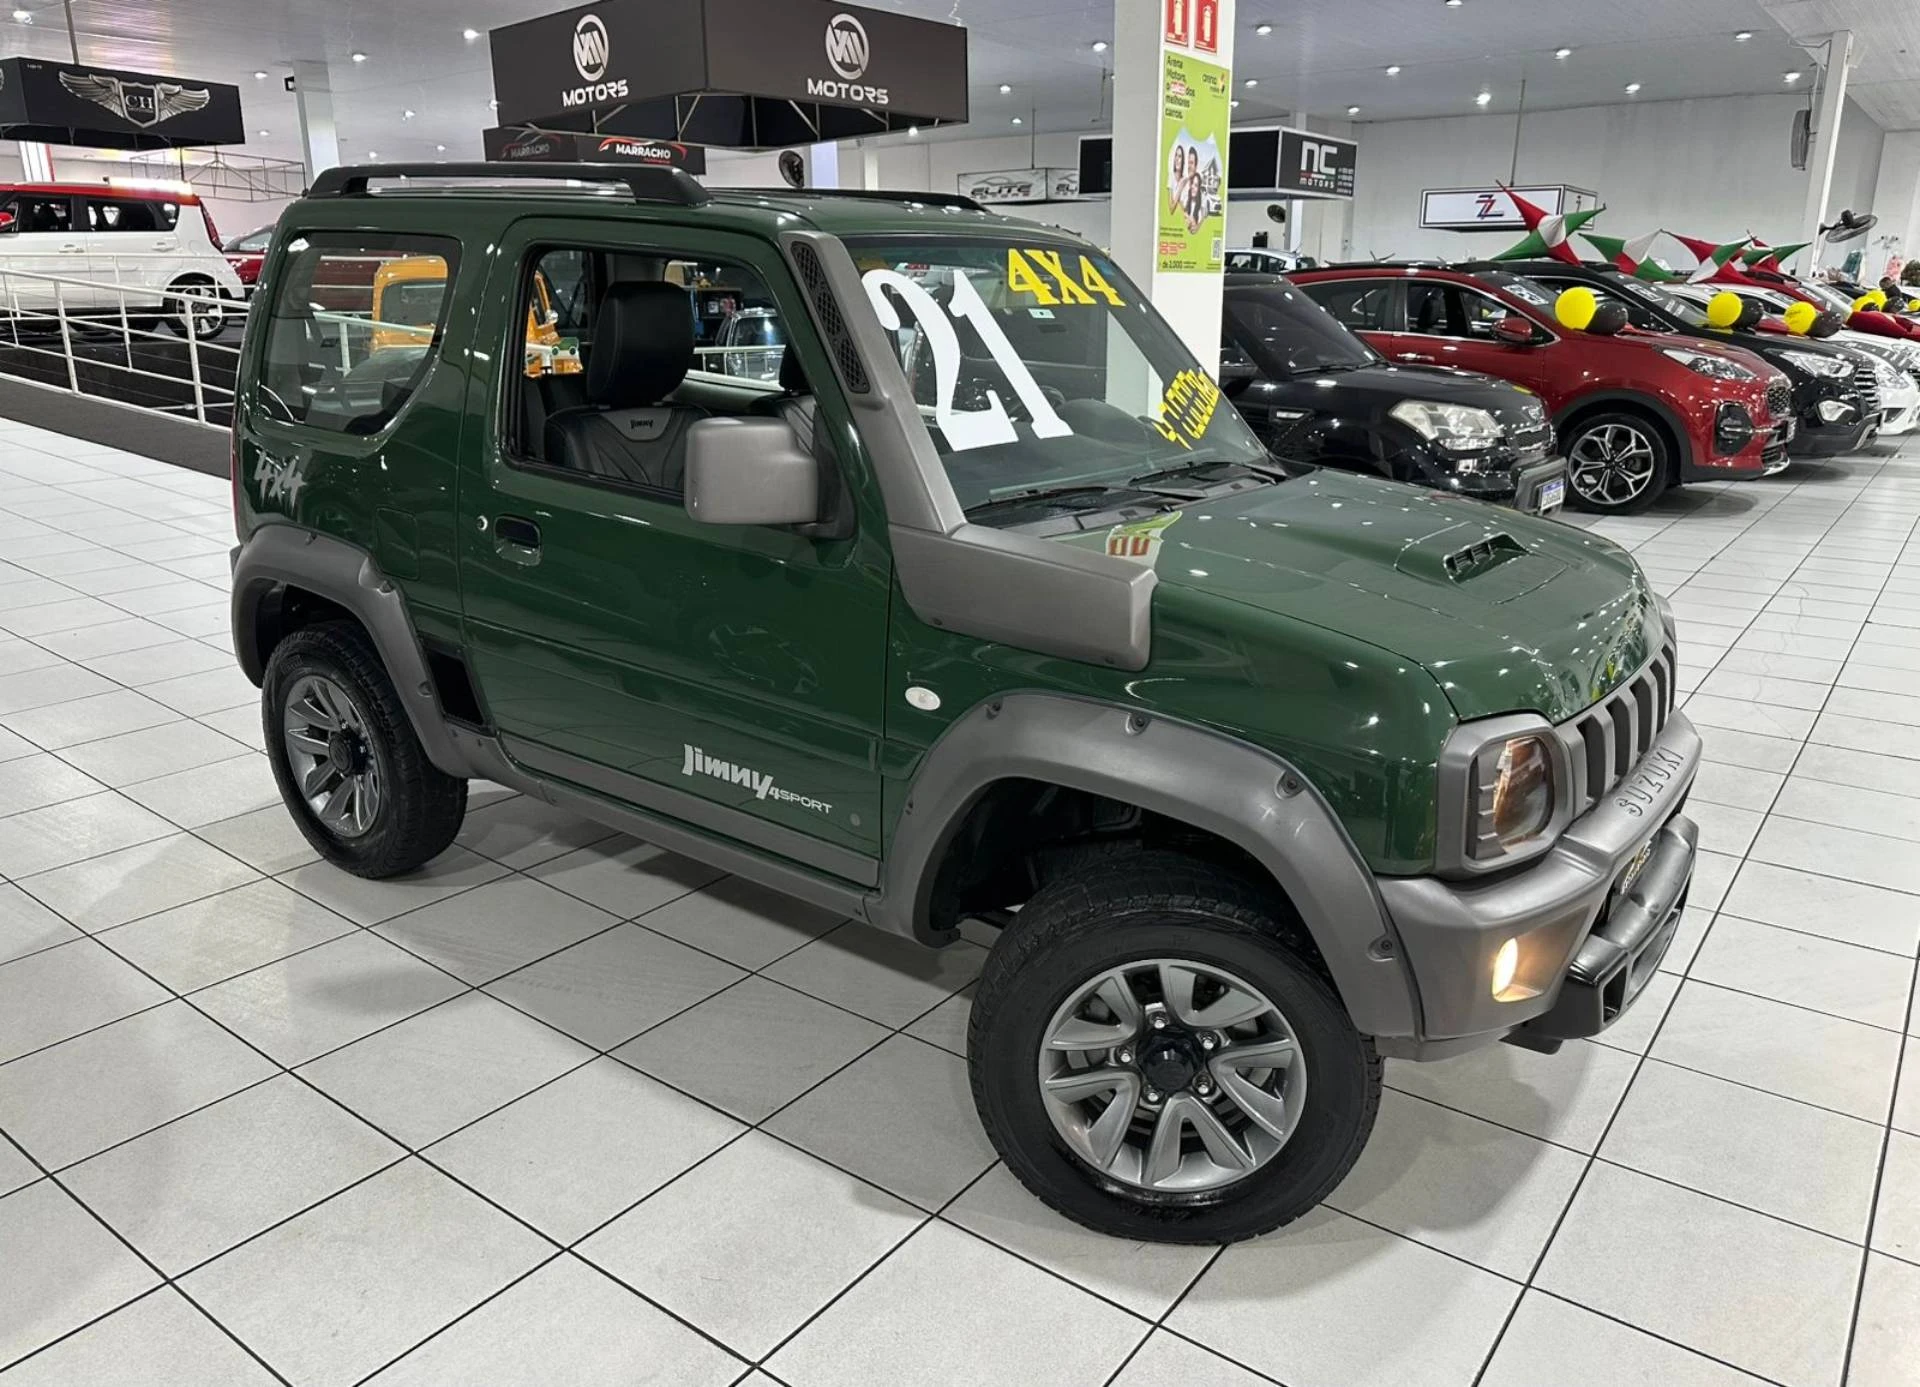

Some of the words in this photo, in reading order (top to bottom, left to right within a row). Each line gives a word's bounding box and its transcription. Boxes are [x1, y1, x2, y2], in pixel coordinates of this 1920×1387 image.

[562, 79, 629, 107] MOTORS
[806, 77, 889, 105] MOTORS
[615, 143, 671, 160] MARRACHO
[861, 269, 1074, 451] 21
[682, 743, 774, 800] Jimny
[1615, 747, 1684, 817] SUZUKI
